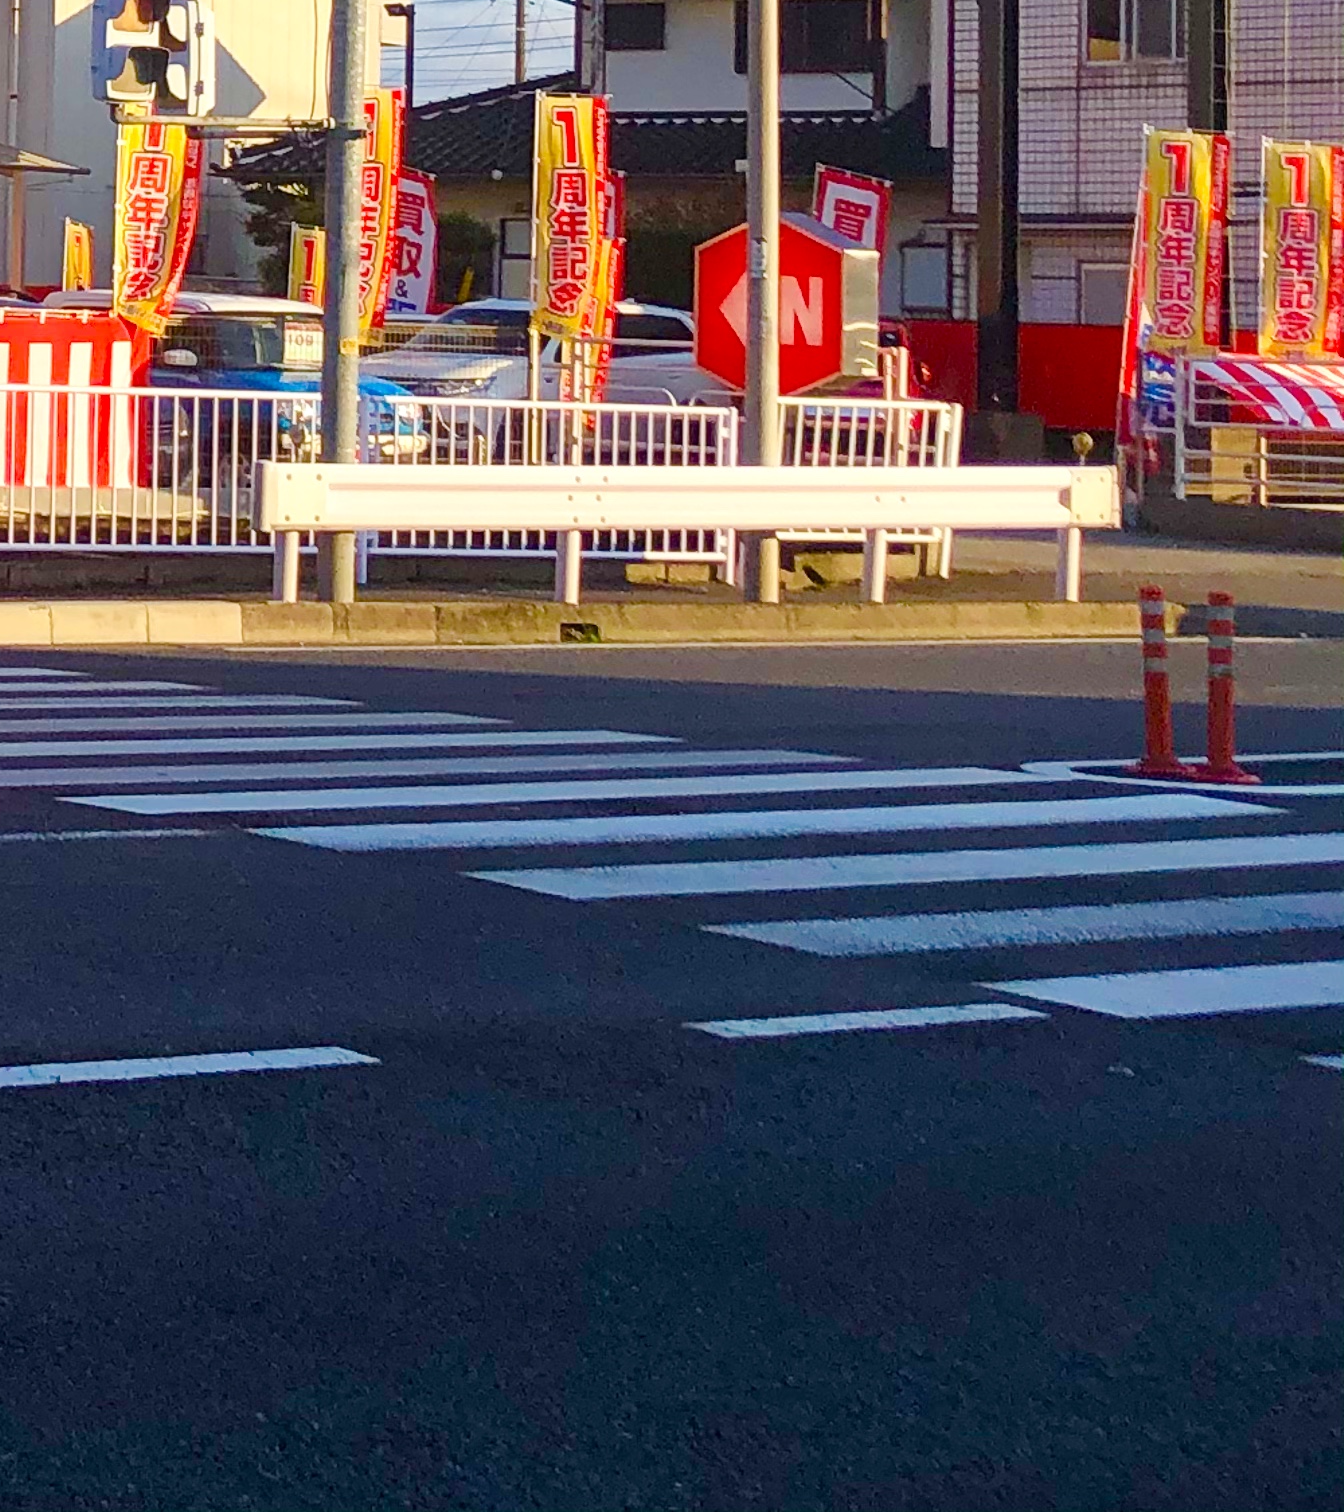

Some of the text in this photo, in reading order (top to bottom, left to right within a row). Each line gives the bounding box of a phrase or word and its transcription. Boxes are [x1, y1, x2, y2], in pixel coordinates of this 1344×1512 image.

[548, 104, 591, 318] 1周年記念
[1155, 141, 1200, 339] 1周年記念
[1273, 152, 1319, 344] 1周年記念
